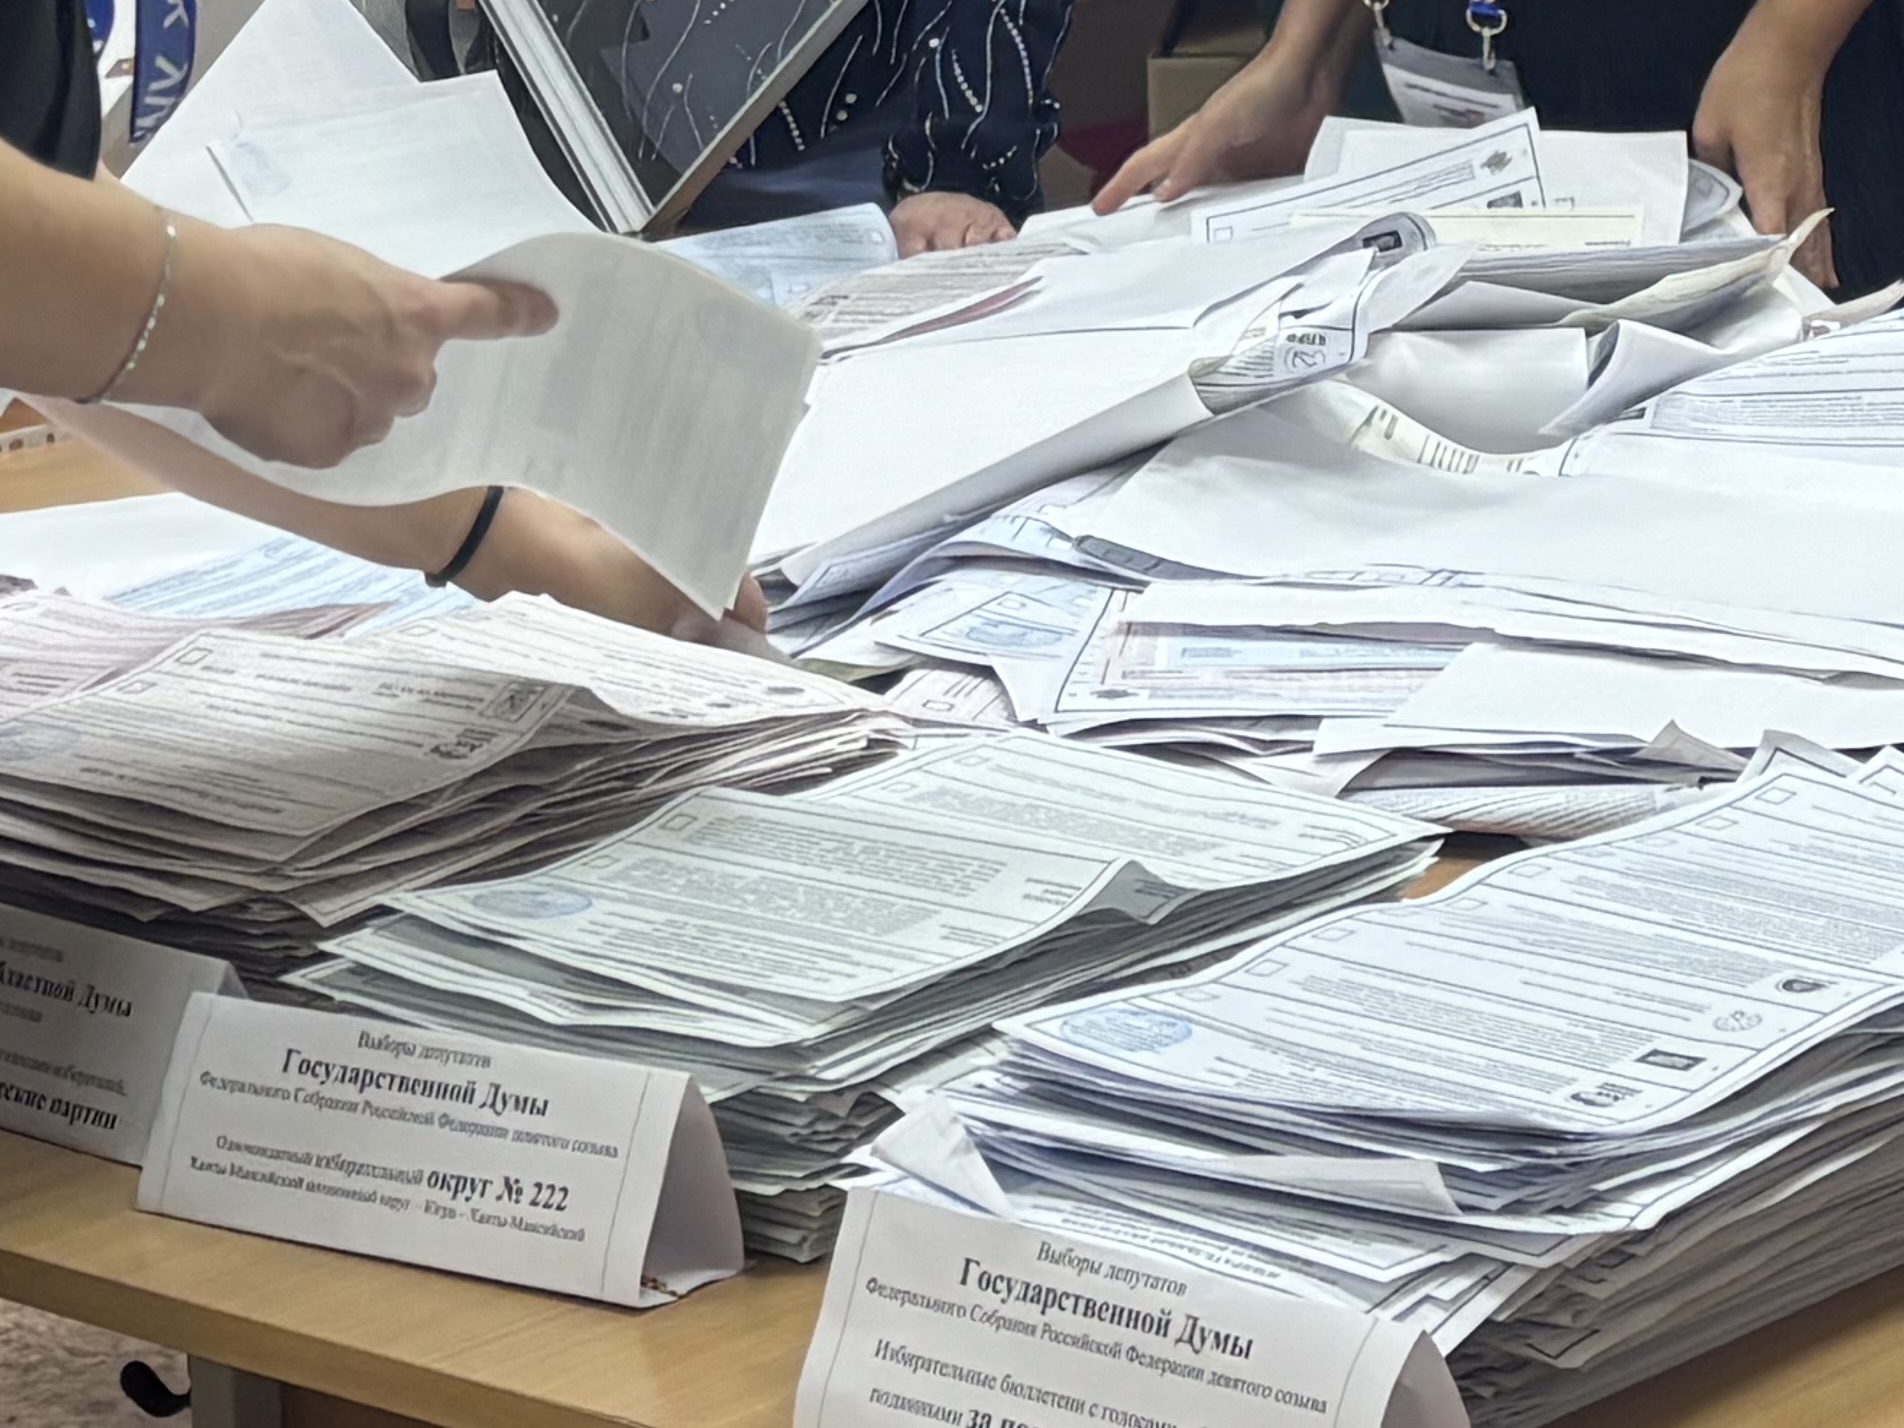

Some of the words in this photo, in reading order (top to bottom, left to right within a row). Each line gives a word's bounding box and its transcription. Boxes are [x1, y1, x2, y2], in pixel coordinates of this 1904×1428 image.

[78, 983, 133, 1018] Думы
[281, 1047, 477, 1105] Государственной
[479, 1082, 549, 1117] Думы
[427, 1169, 494, 1203] округ
[495, 1175, 524, 1204] №
[528, 1181, 570, 1212] 222
[1036, 1240, 1103, 1276] Выборы
[1104, 1263, 1188, 1297] депутатов
[866, 1276, 967, 1321] Федерального
[969, 1302, 1037, 1337] Собрания
[1040, 1322, 1122, 1361] Российской
[1125, 1345, 1205, 1382] Федерации
[959, 1257, 1173, 1339] Государственной
[1175, 1313, 1254, 1360] Думы
[874, 1338, 998, 1392] Избирательные
[1000, 1372, 1086, 1415] бюллетени
[1088, 1402, 1099, 1418] с
[1101, 1404, 1178, 1428] голосам
